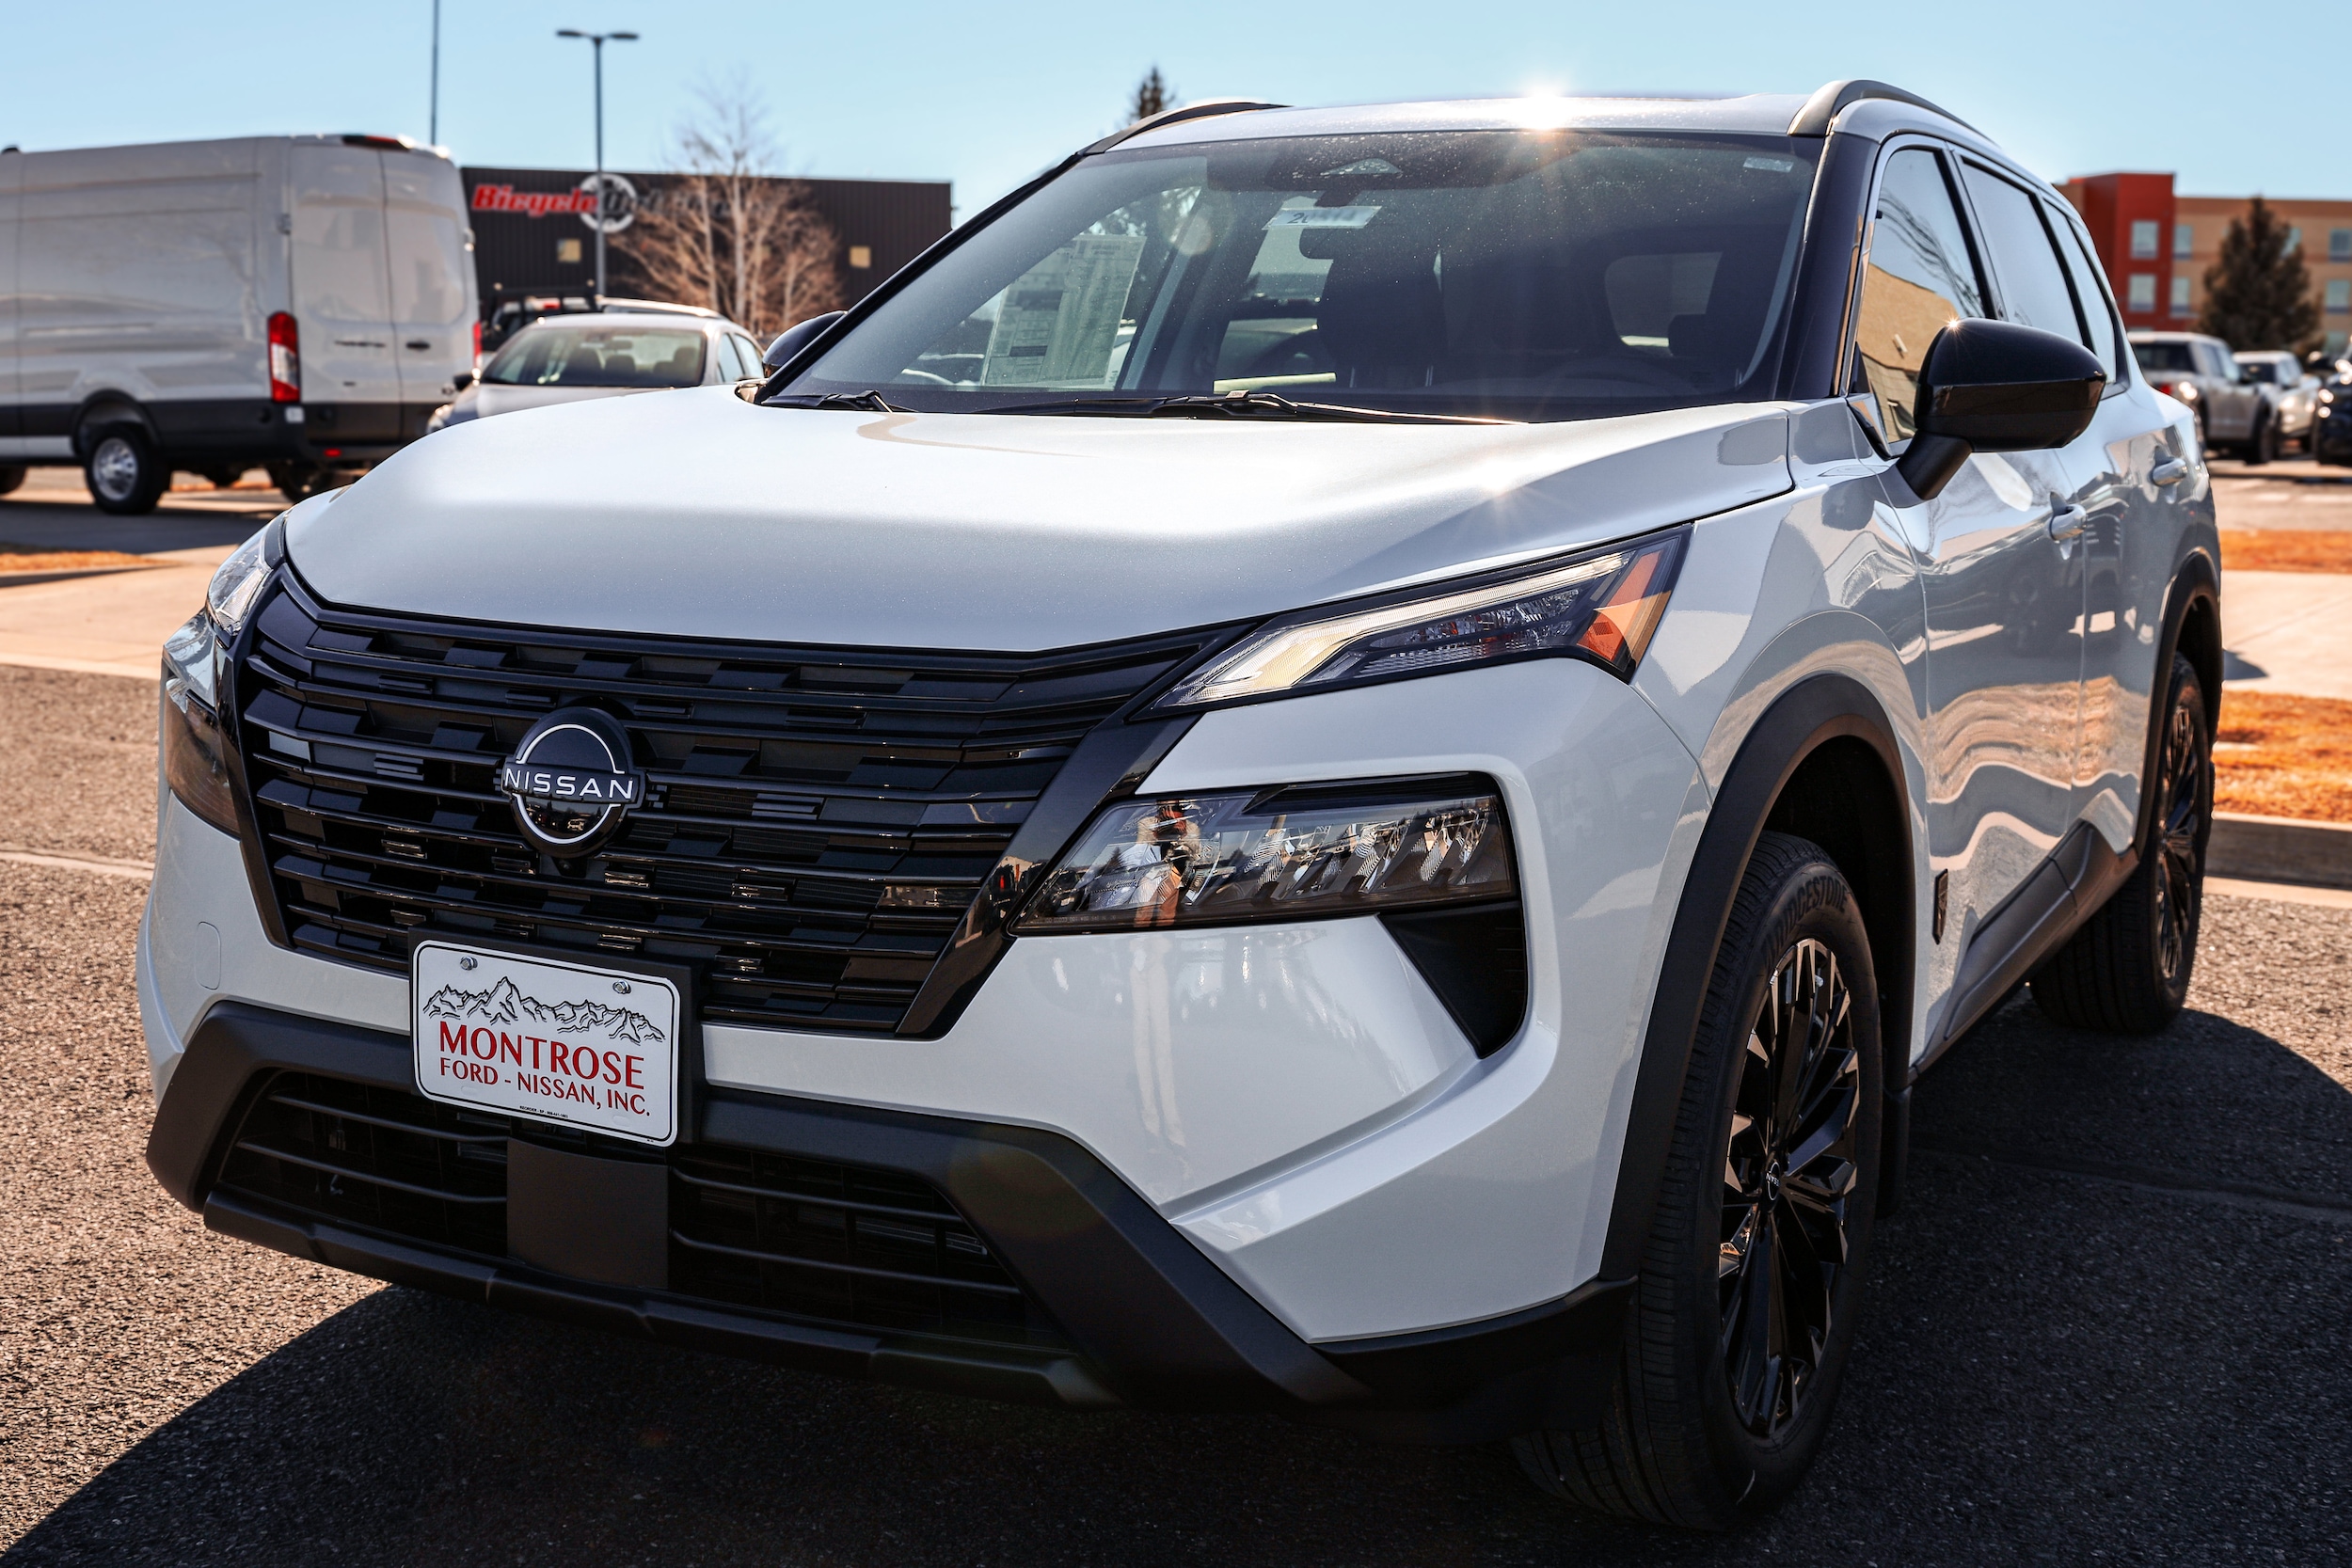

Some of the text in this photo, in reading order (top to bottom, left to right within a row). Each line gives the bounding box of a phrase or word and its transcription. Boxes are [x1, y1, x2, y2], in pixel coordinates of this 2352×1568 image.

[472, 184, 598, 216] Bicycle
[504, 768, 633, 800] NISSAN
[439, 1021, 644, 1089] MONTROSE
[439, 1057, 499, 1085] FORD
[517, 1072, 601, 1109] NISSAN,
[607, 1088, 650, 1117] INC.
